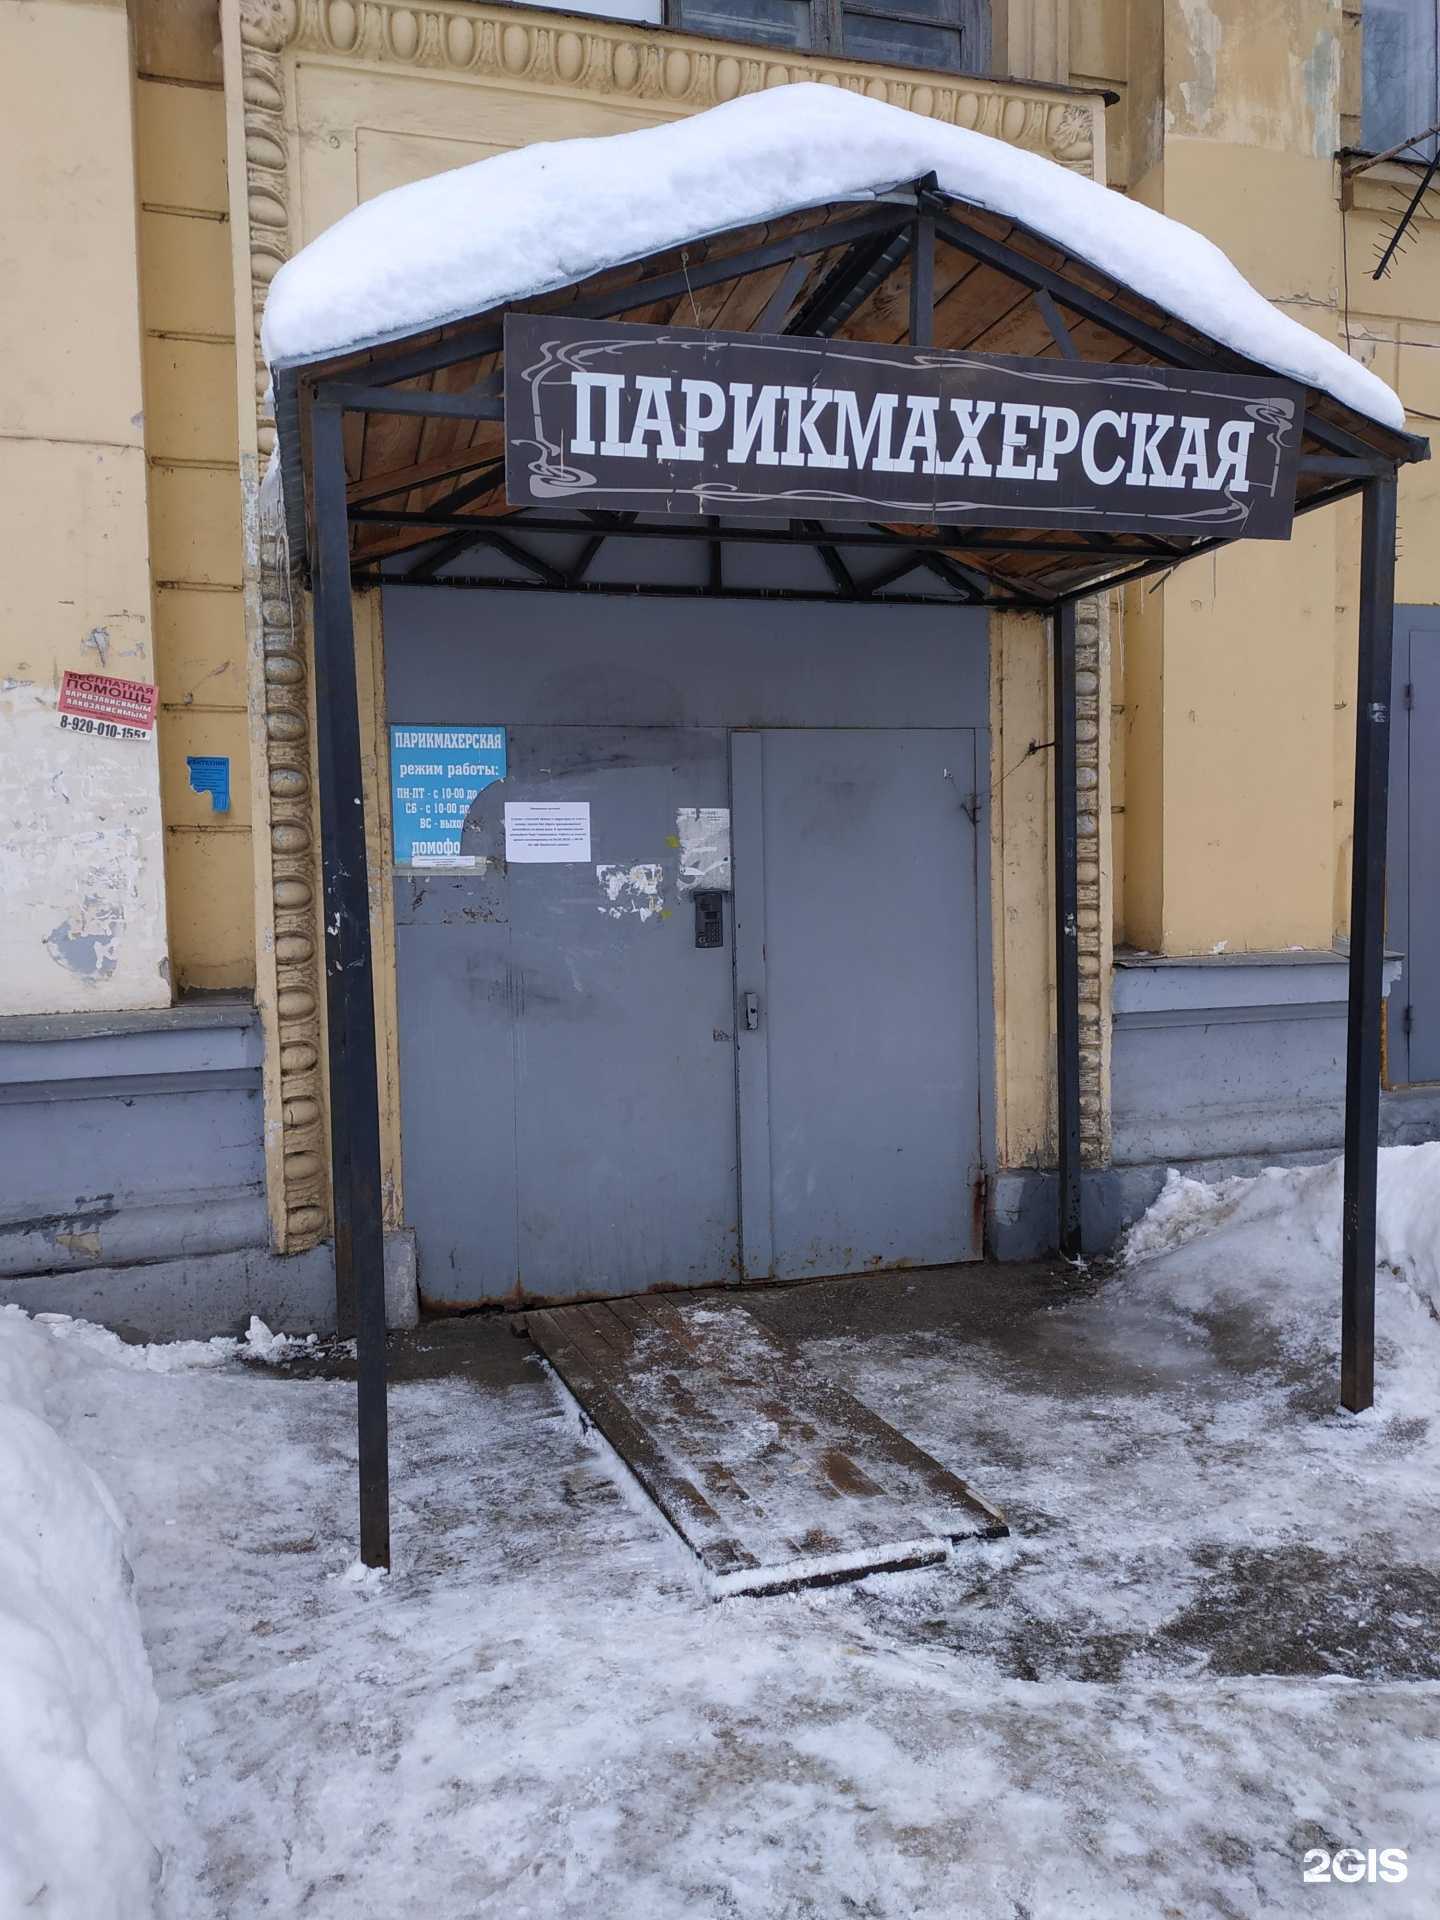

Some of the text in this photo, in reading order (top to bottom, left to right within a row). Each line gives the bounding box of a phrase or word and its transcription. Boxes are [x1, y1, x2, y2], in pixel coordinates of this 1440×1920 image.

[570, 371, 1252, 493] ПАРИКМАХЕРСКАЯ
[67, 678, 152, 704] ПОМОЩЬ
[69, 673, 154, 695] БЕСПЛАТНАЯ
[395, 732, 502, 749] ПАРИКМАХЕРСКАЯ
[399, 762, 500, 778] режим работы:
[397, 787, 425, 799] ПН-ПТ
[442, 787, 465, 799] 10-00
[434, 802, 458, 814] 10-00
[420, 818, 432, 829] ВС
